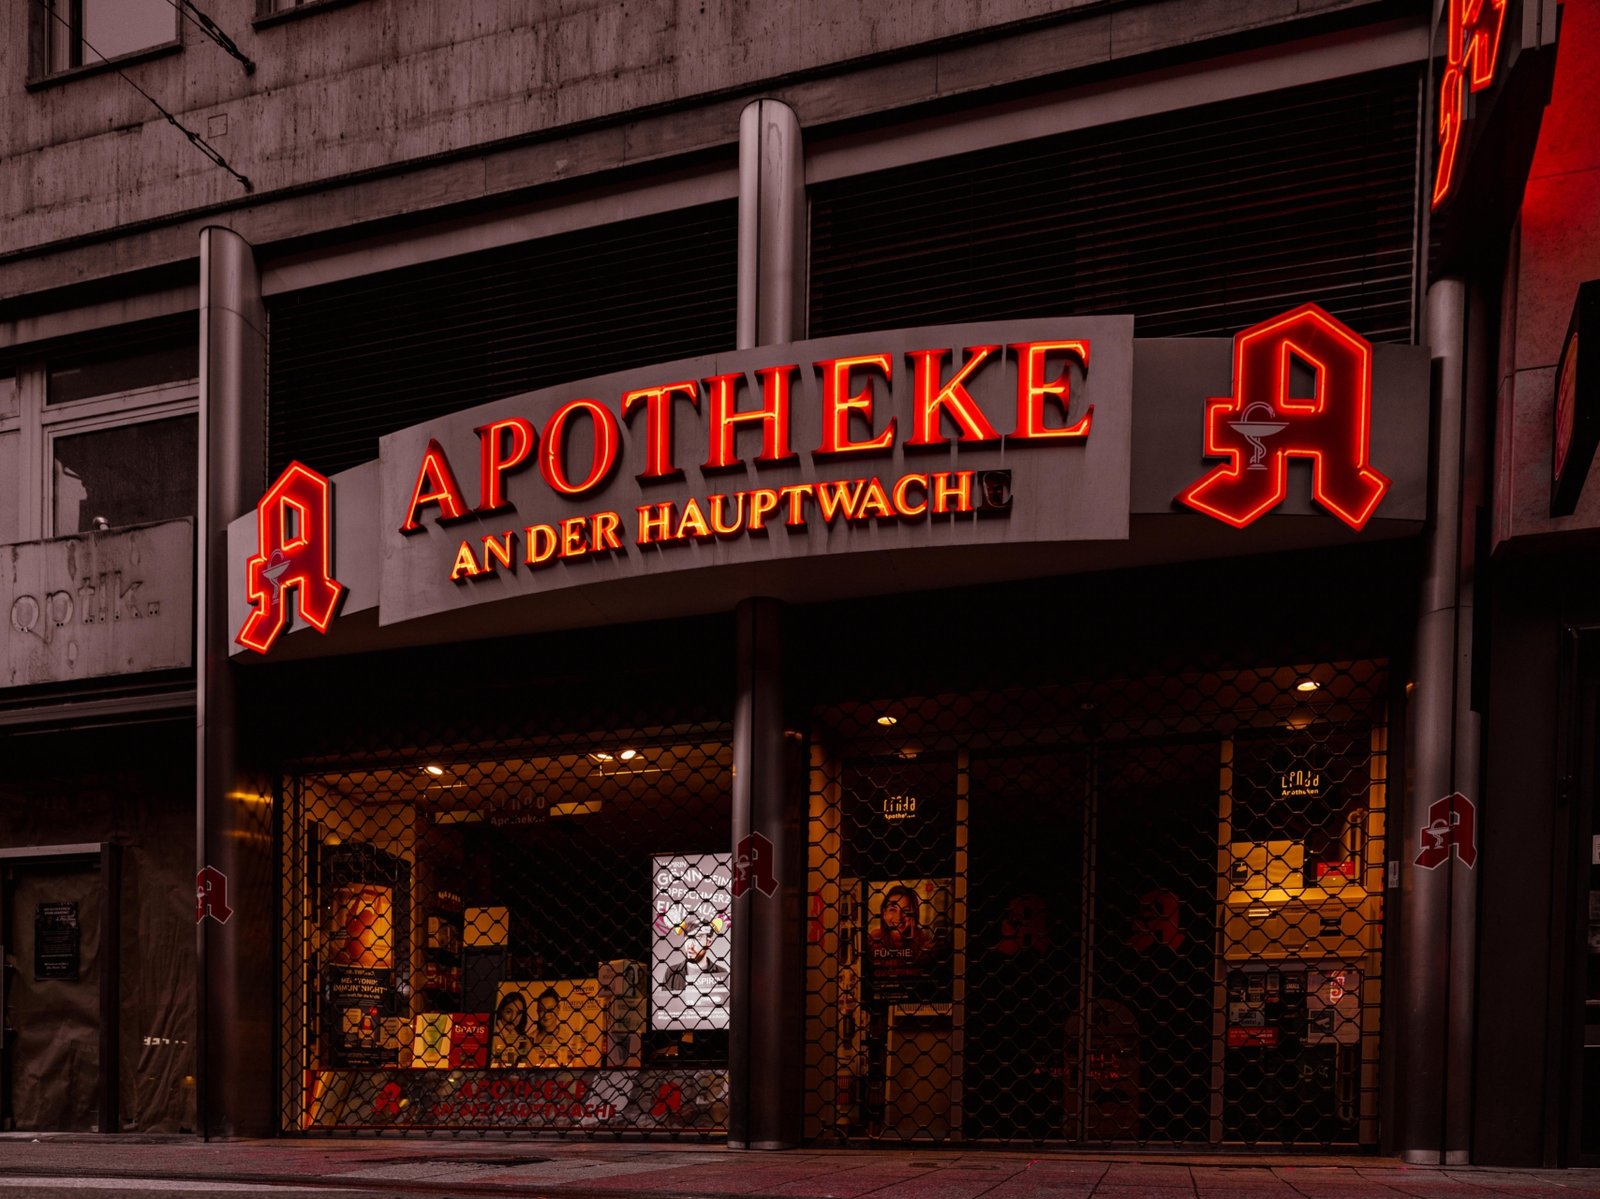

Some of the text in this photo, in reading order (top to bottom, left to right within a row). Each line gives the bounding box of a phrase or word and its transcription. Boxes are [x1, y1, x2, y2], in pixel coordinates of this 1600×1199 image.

[399, 338, 1095, 535] APOTHEKE
[449, 530, 514, 582] AN
[524, 511, 624, 566] DER
[454, 1024, 486, 1034] GRATIS
